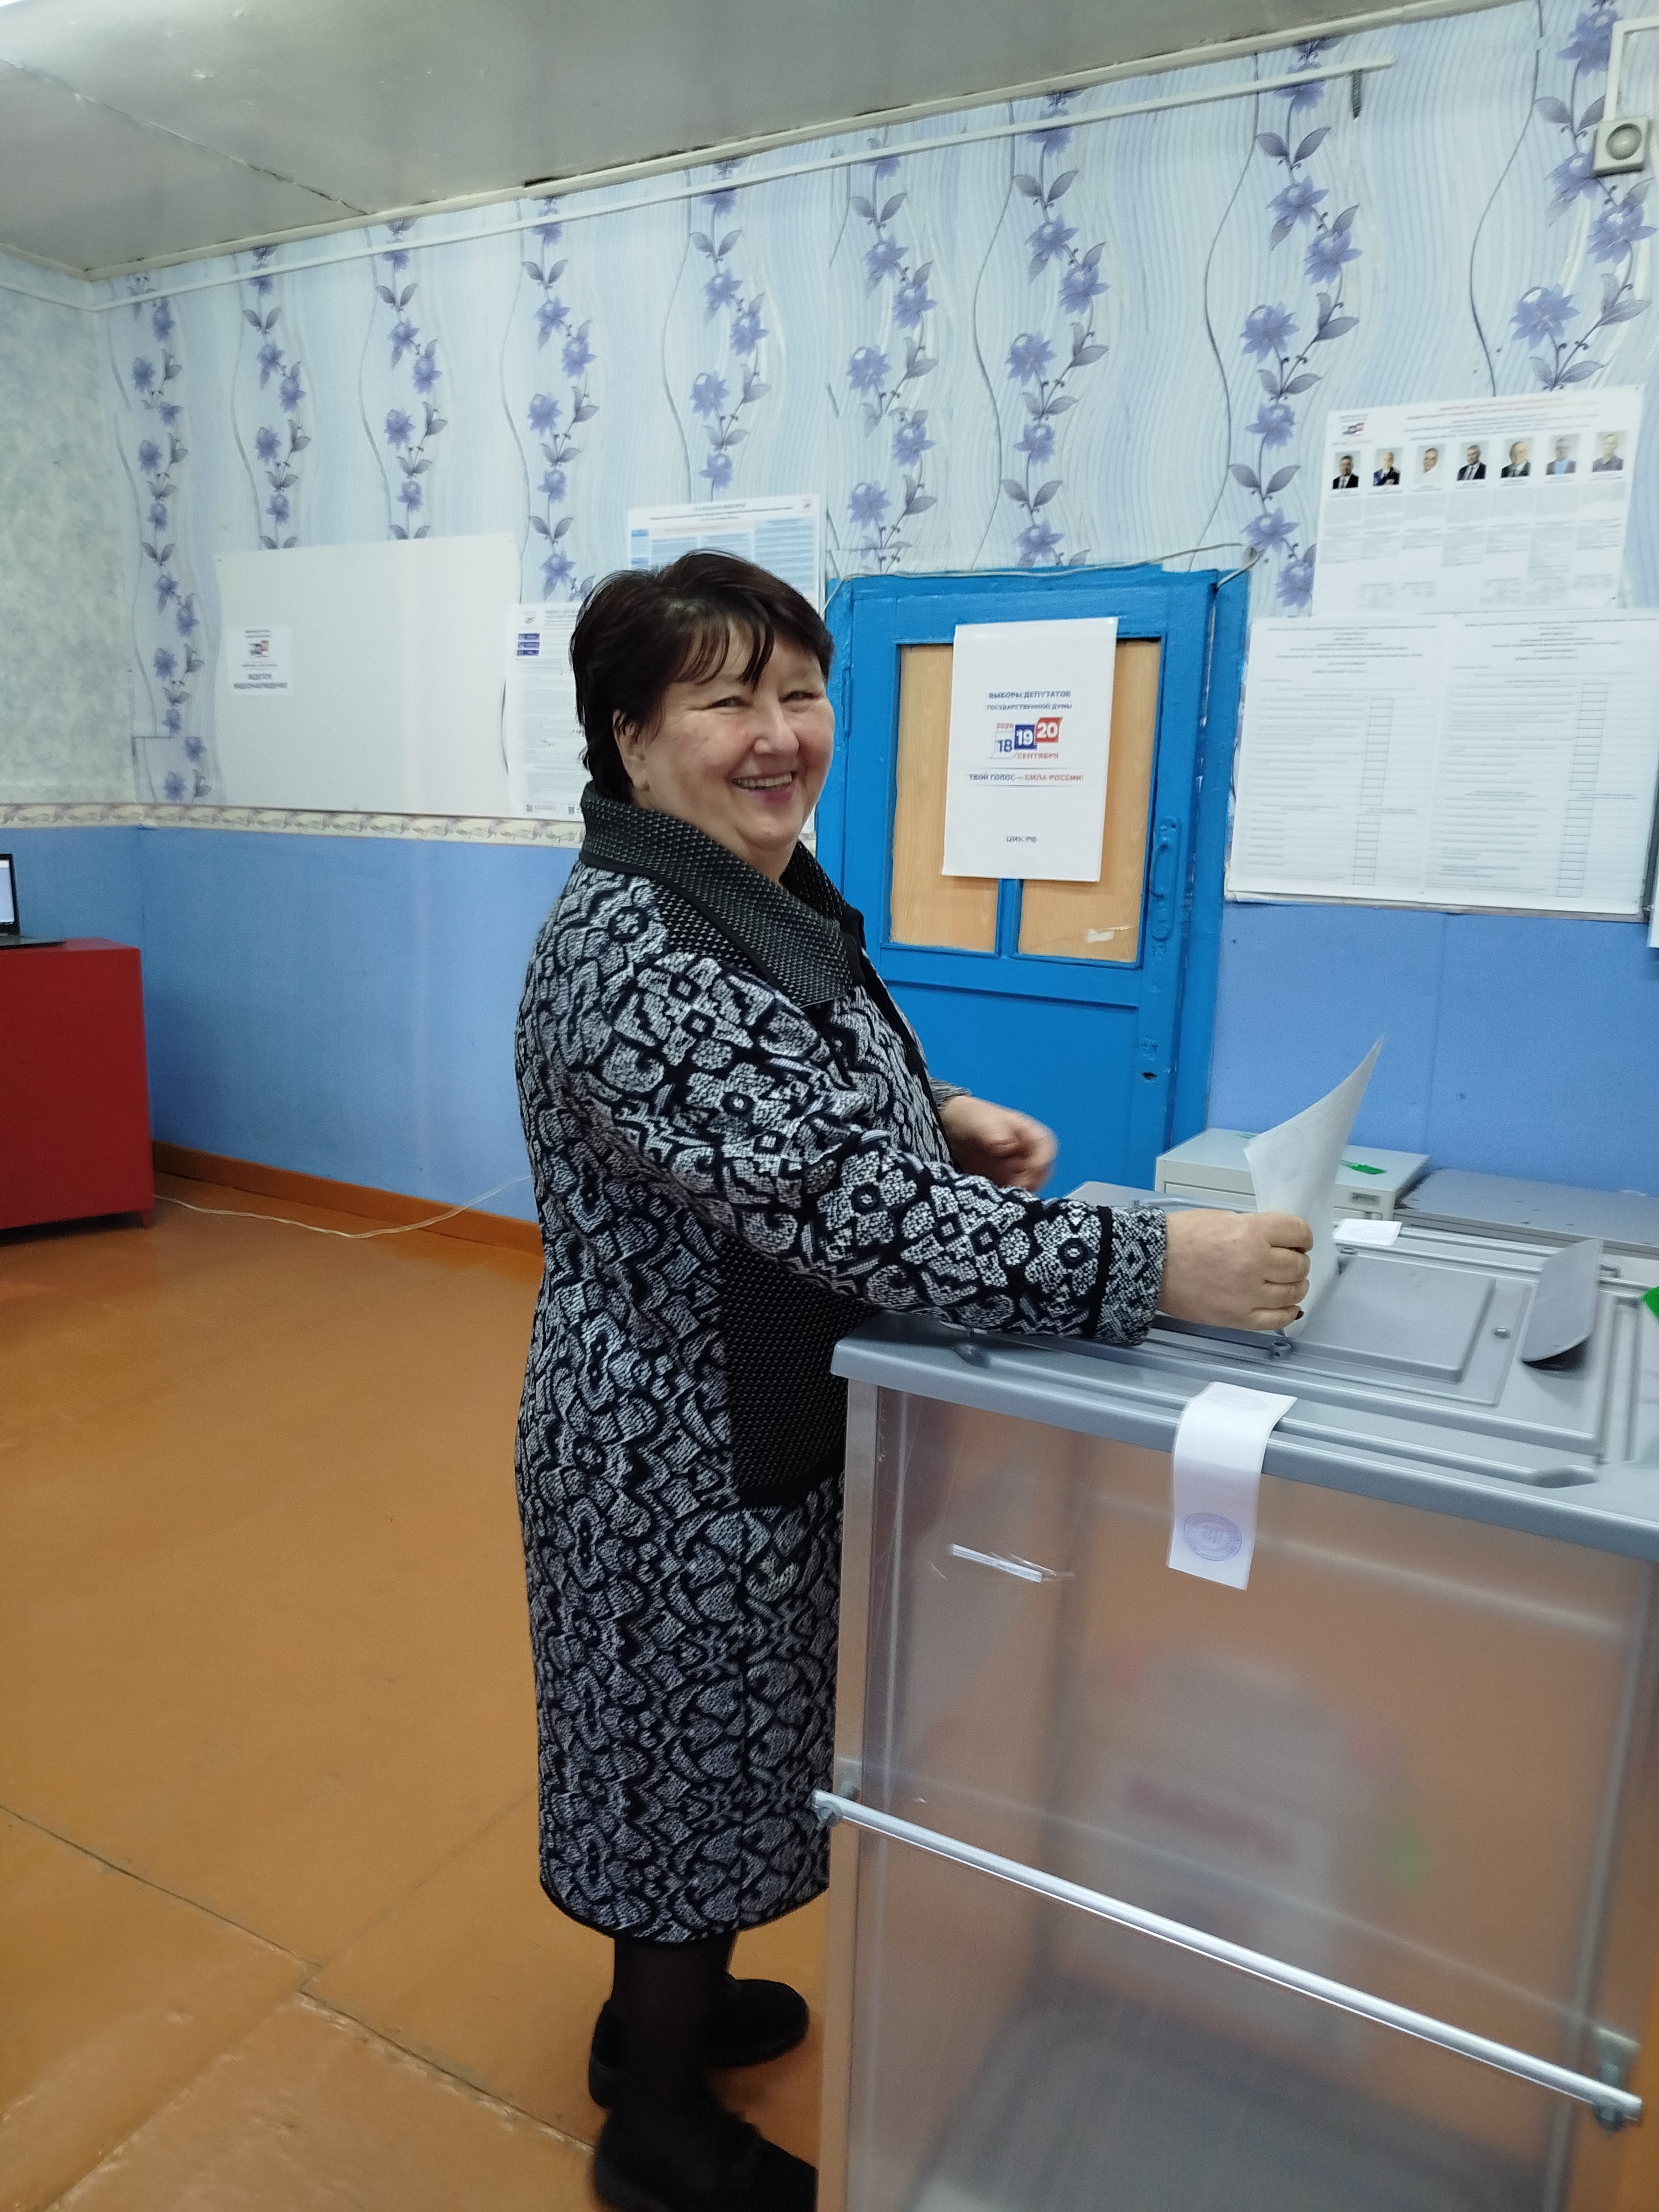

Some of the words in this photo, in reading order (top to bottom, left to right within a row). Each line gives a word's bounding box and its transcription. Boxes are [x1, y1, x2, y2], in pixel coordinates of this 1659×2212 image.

[1024, 691, 1071, 699] ДЕПУТАТОВ
[998, 739, 1012, 753] 18
[1016, 728, 1033, 746] 19
[1037, 722, 1058, 739] 20
[969, 772, 988, 781] ТВОЙ
[990, 773, 1015, 781] ГОЛОС
